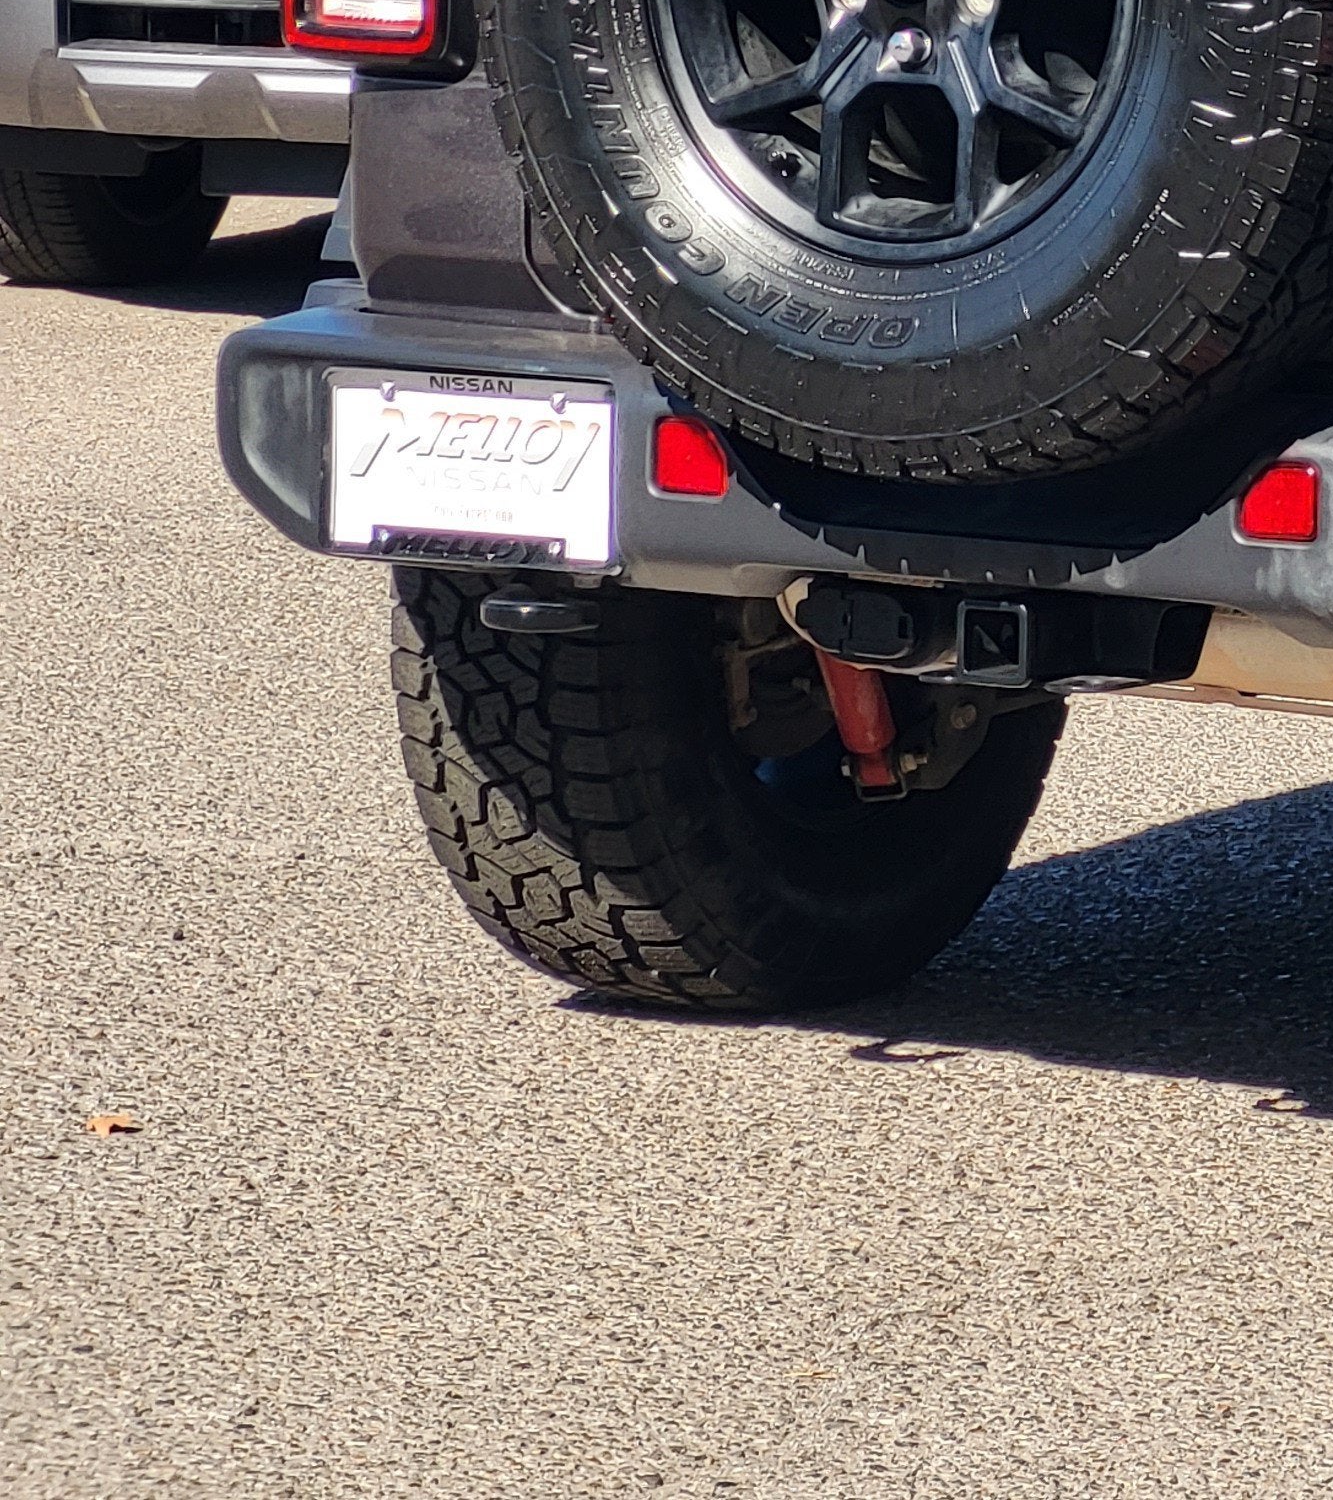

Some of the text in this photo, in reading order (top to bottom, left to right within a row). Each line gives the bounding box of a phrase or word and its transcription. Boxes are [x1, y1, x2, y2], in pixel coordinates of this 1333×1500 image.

[723, 272, 921, 349] OPEN
[429, 375, 514, 395] NISSAN
[349, 407, 601, 492] MELLOY
[405, 465, 544, 496] NISSAN
